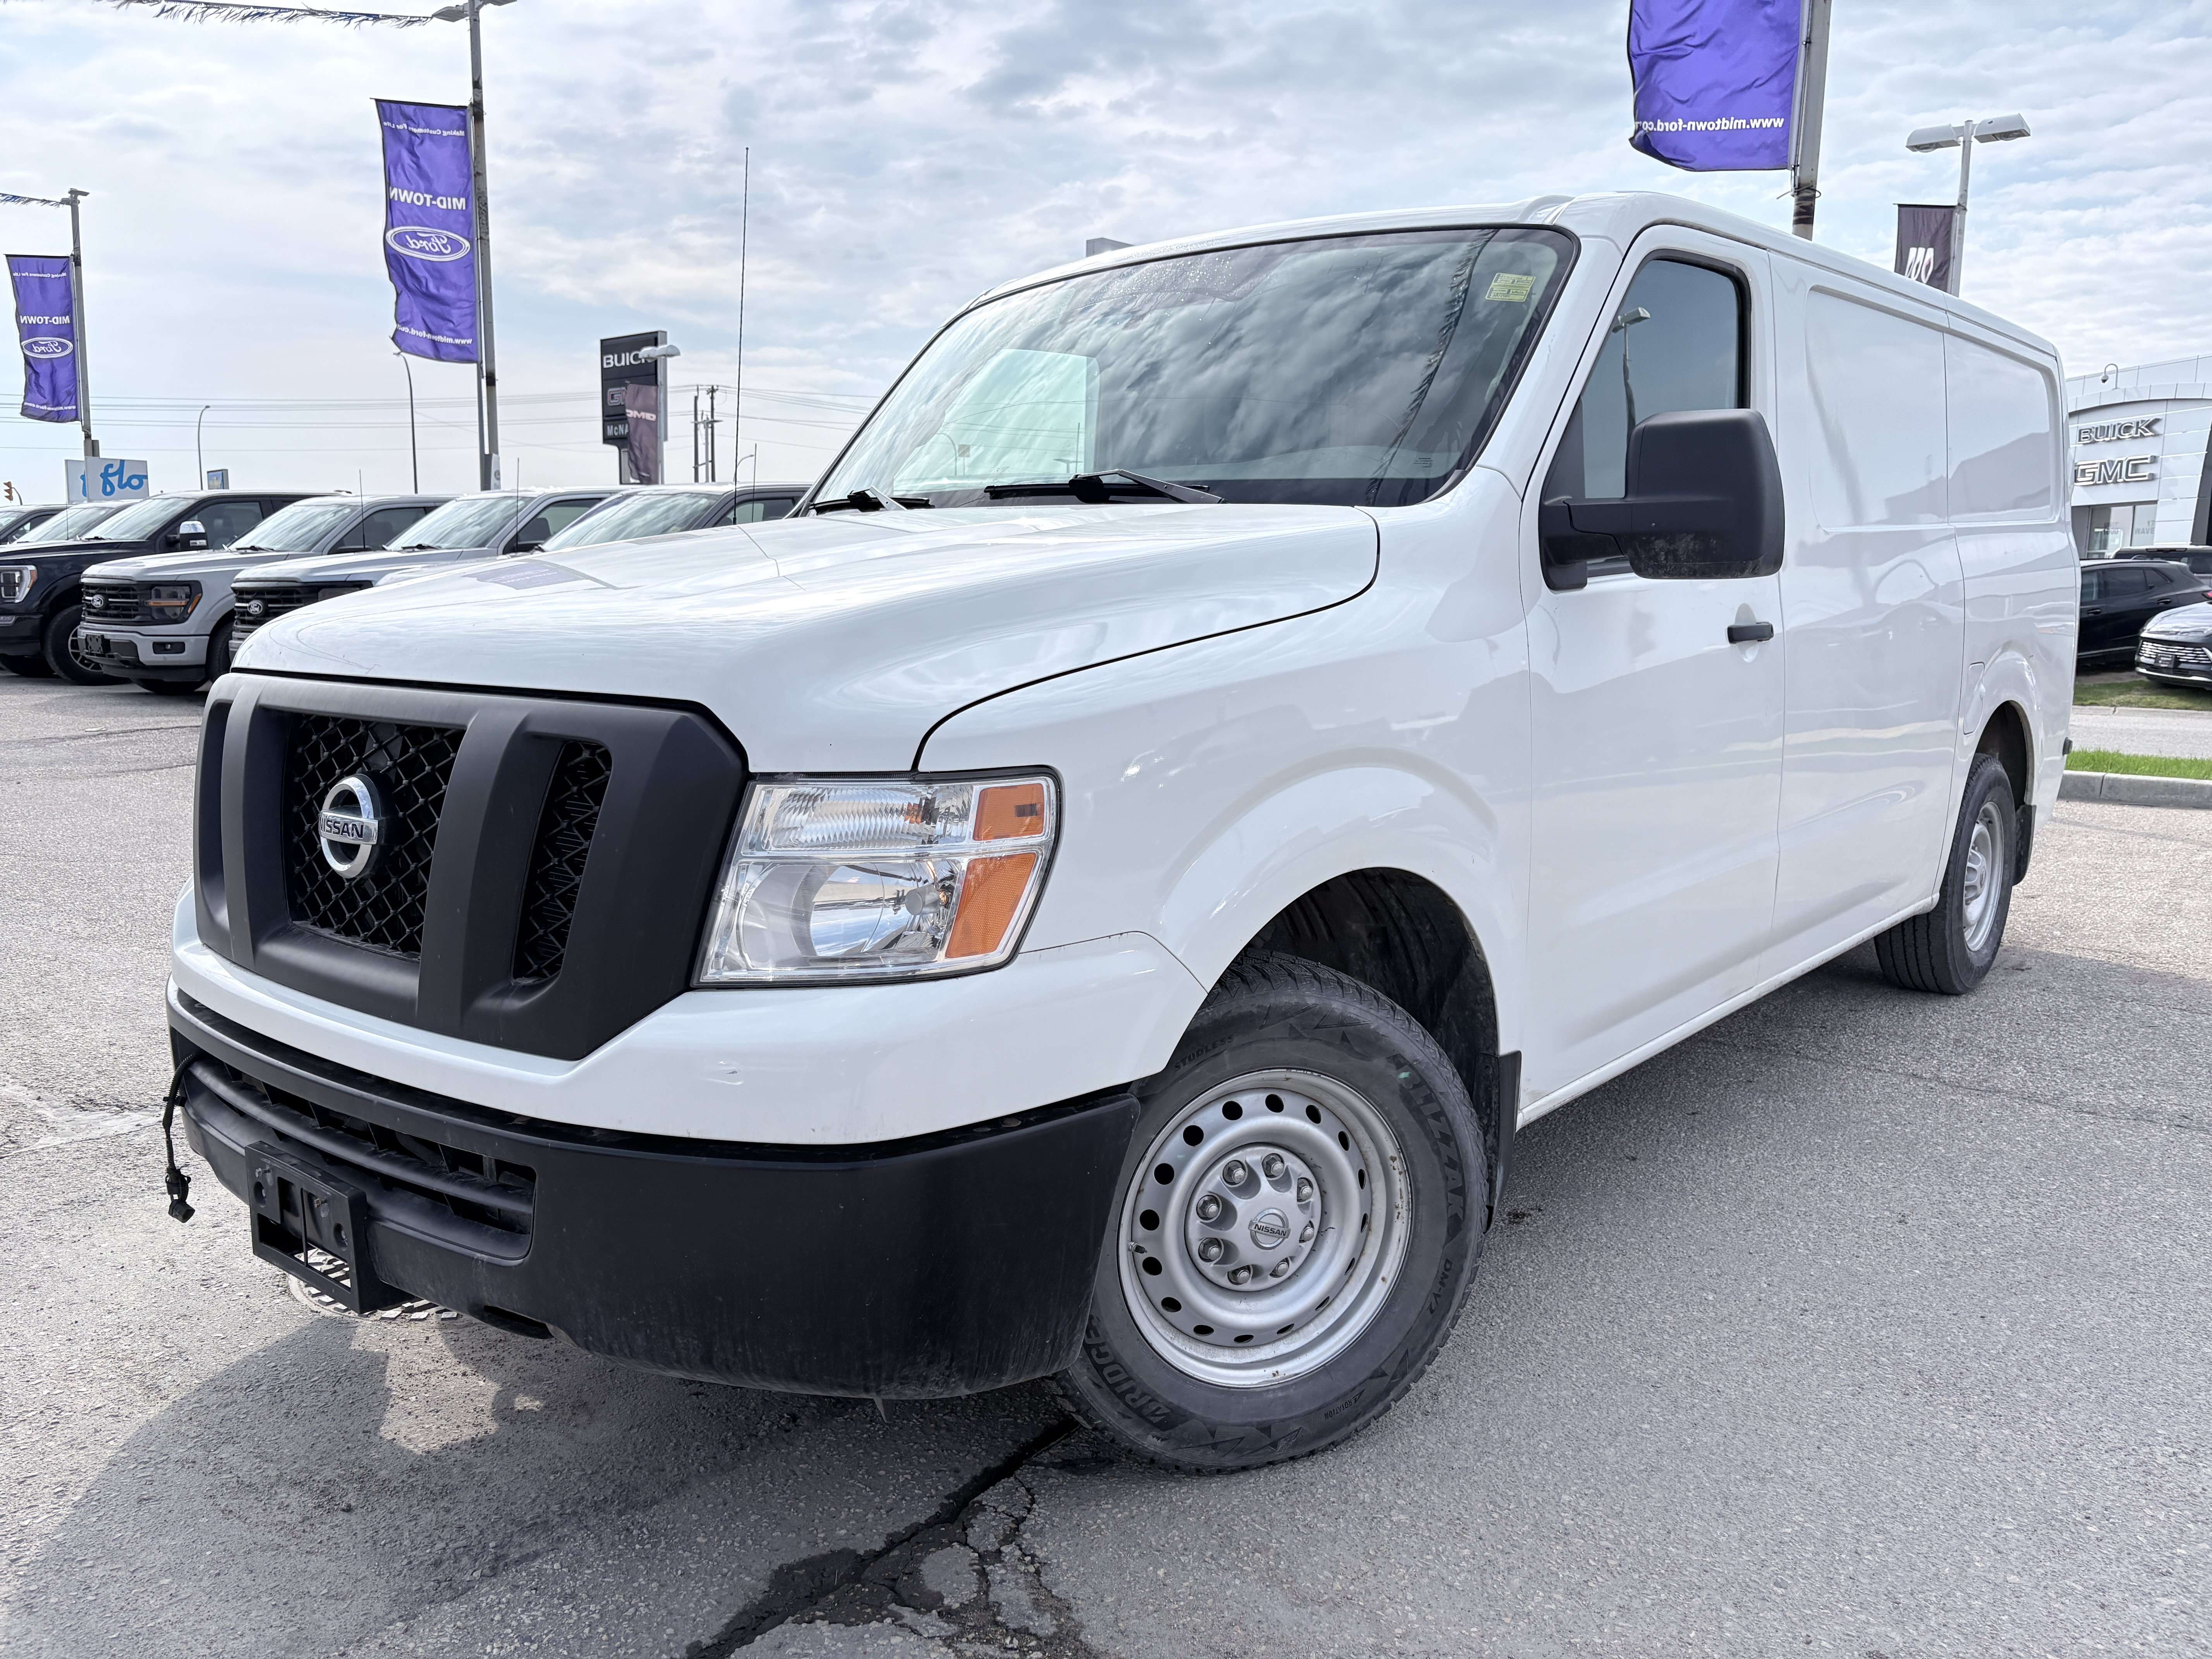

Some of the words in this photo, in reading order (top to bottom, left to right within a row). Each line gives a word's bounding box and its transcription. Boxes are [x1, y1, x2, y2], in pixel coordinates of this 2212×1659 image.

[2077, 418, 2156, 444] BUICK
[100, 459, 148, 496] flo
[2074, 455, 2156, 486] GMC
[319, 816, 364, 839] NISSAN
[1254, 1223, 1287, 1237] NISSAN
[1084, 1314, 1171, 1424] BRIDGE
